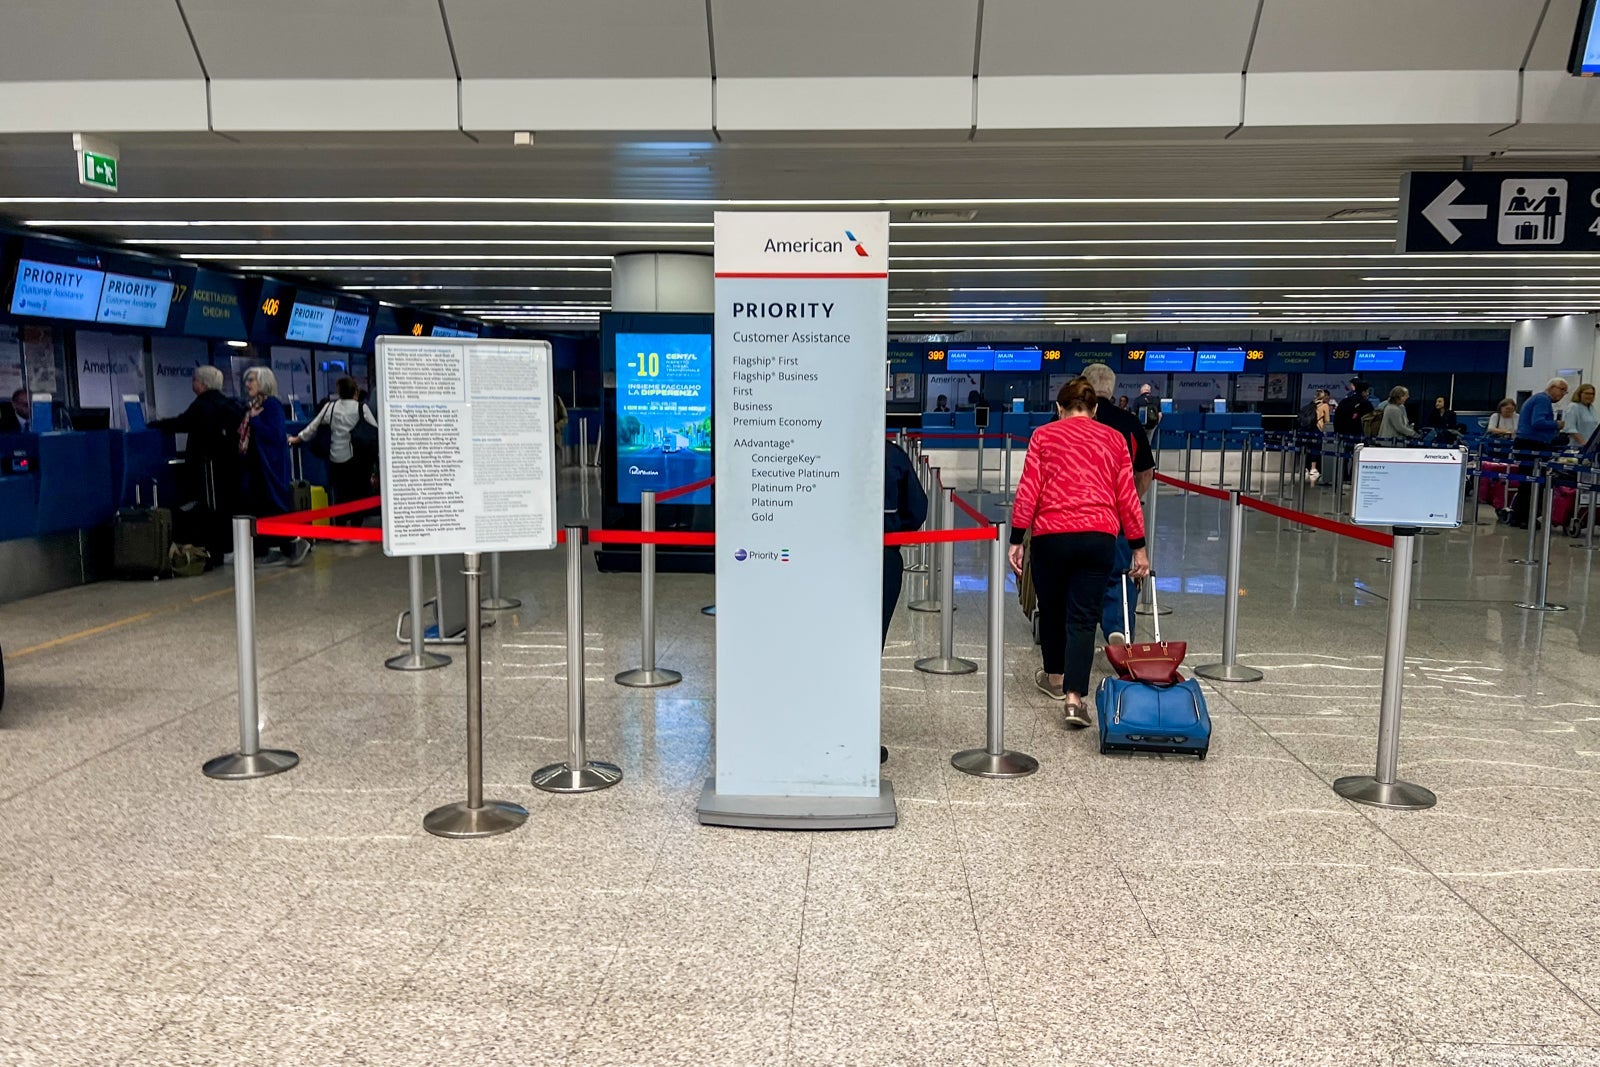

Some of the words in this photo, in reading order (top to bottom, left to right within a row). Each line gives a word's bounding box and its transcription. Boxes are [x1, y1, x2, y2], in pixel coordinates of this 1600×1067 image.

[764, 238, 843, 254] American
[23, 267, 83, 288] PRIORITY
[108, 279, 157, 298] PRIORITY
[262, 297, 280, 316] 406
[733, 302, 835, 319] PRIORITY
[294, 308, 325, 321] PRIORITY
[334, 315, 360, 327] PRIORITY
[733, 331, 790, 344] Customer
[792, 331, 851, 344] Assistance
[927, 350, 945, 361] 399
[1043, 350, 1061, 361] 398
[1127, 350, 1146, 361] 397
[1246, 350, 1265, 360] 396
[1332, 350, 1351, 359] 395
[627, 352, 660, 377] -10
[778, 356, 799, 366] First
[778, 371, 819, 382] Business
[930, 376, 966, 384] American
[661, 383, 702, 391] FACCIAMO
[1178, 381, 1212, 389] American
[641, 389, 699, 397] DIFFERENZA
[733, 386, 753, 396] First
[733, 401, 773, 412] Business
[733, 416, 777, 427] Premium
[779, 416, 823, 429] Economy
[751, 468, 796, 478] Executive
[798, 468, 840, 478] Platinum
[751, 483, 794, 493] Platinum
[751, 498, 794, 508] Platinum
[751, 512, 774, 522] Gold
[749, 550, 779, 561] Priority
